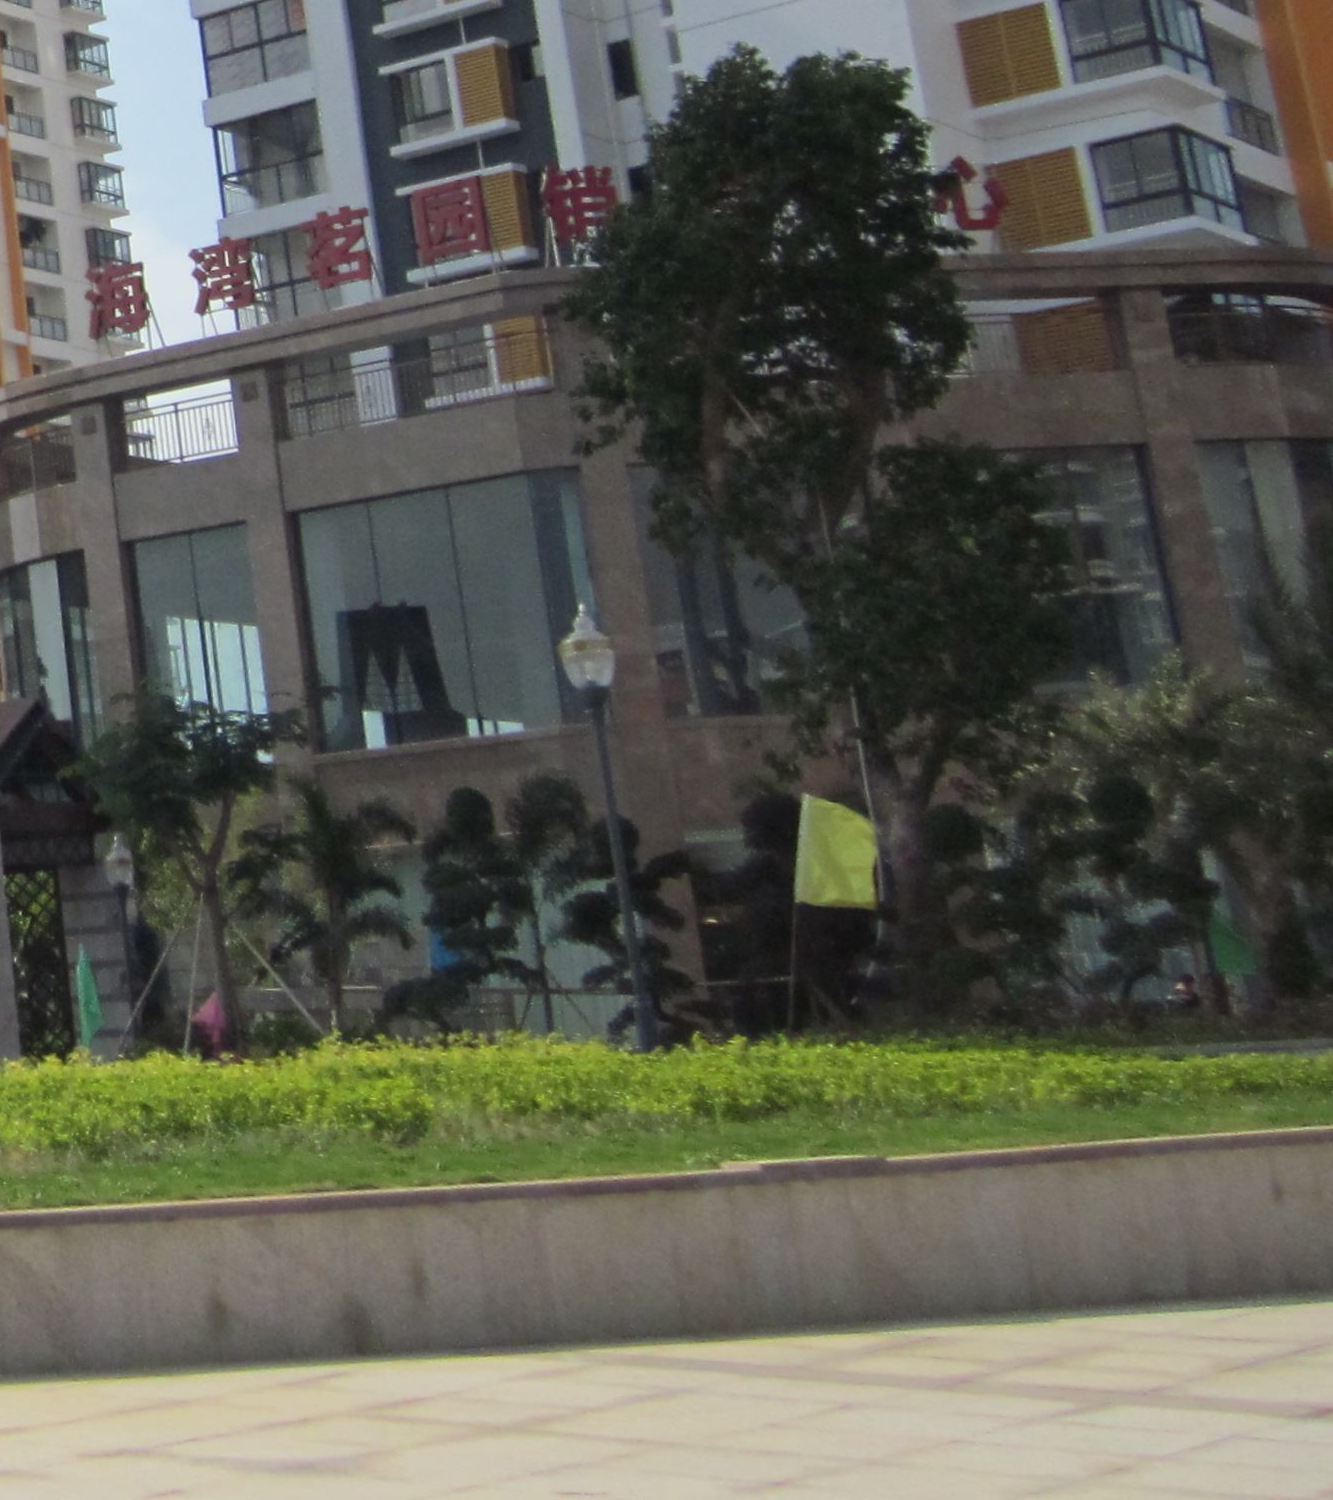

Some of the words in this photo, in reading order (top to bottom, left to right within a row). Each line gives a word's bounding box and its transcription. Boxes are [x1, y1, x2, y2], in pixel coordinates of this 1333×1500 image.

[84, 155, 1009, 340] 海湾茗园销心
